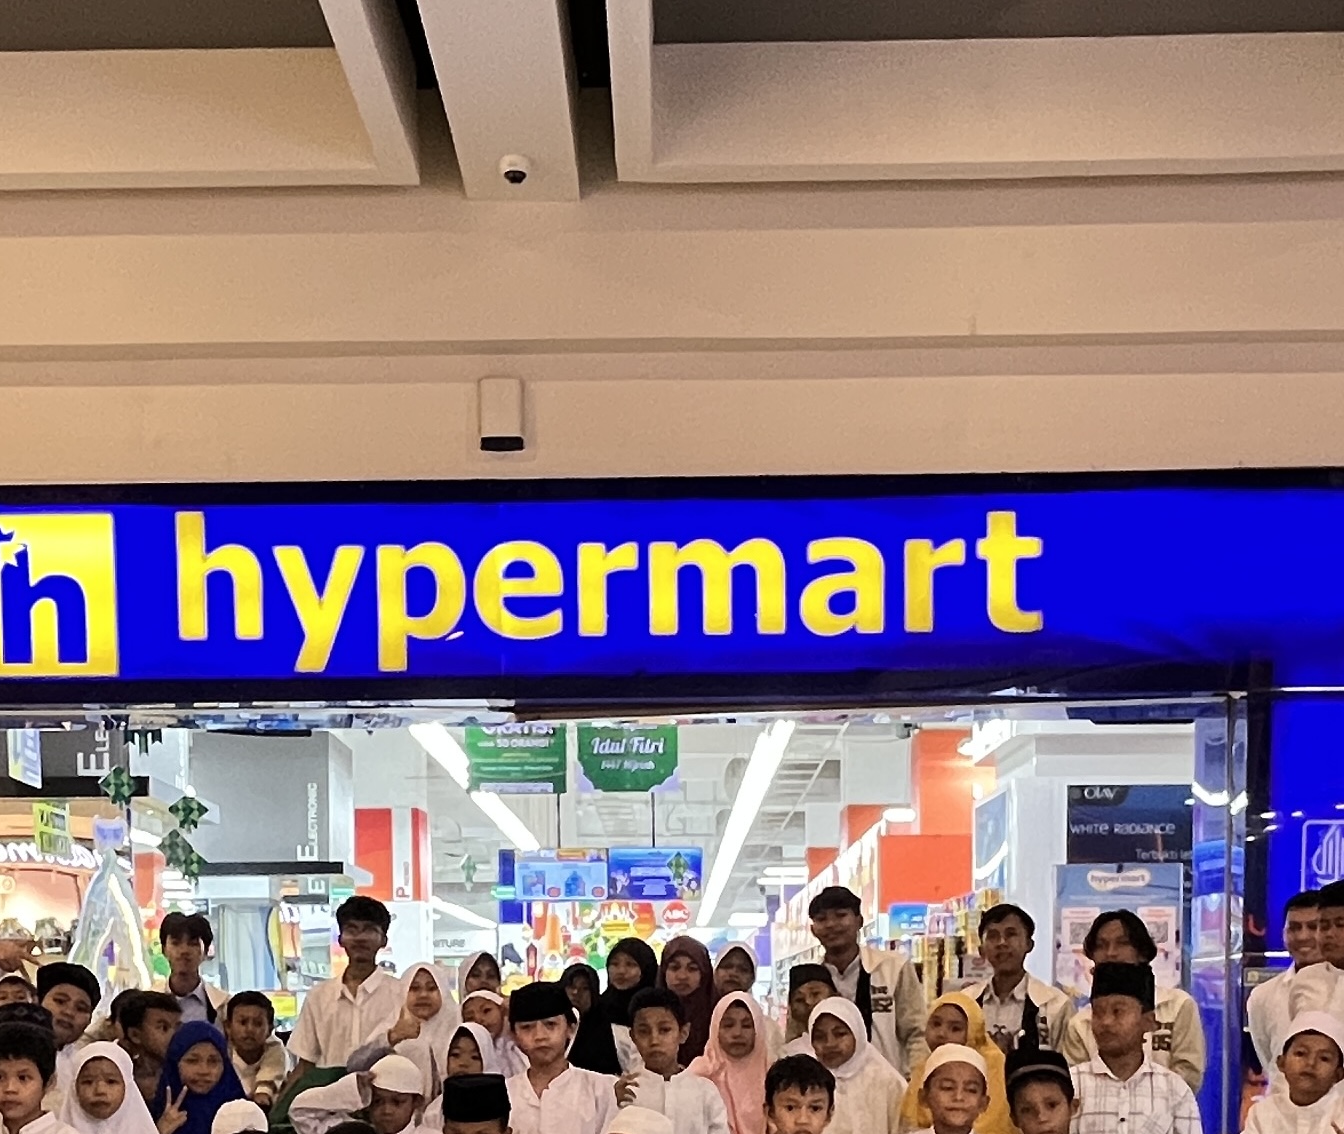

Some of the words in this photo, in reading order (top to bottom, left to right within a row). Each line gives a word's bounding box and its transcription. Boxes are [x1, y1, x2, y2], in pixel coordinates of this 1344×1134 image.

[175, 510, 1044, 673] hypermart
[590, 737, 627, 754] Idul
[631, 736, 664, 754] Fitri
[297, 782, 318, 862] ELECTRONIC
